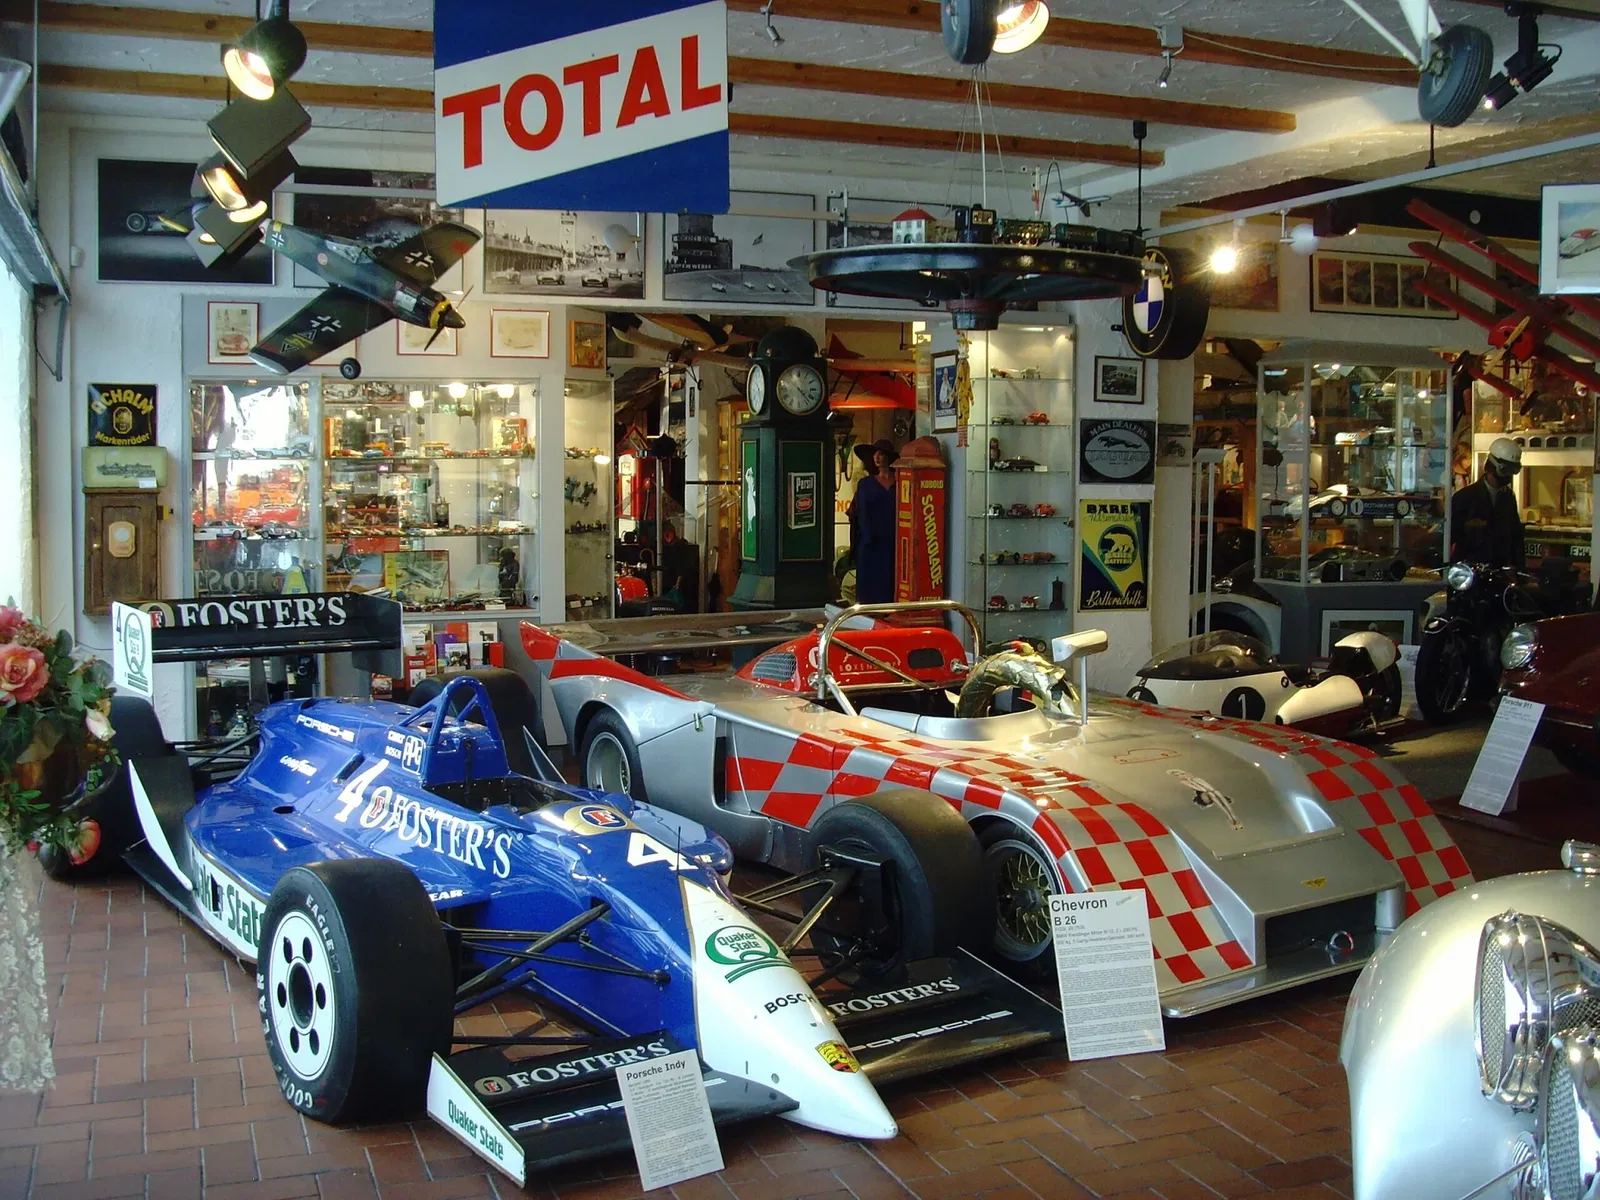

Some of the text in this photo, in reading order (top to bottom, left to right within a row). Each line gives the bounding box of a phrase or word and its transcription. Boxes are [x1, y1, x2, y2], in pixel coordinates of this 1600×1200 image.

[442, 35, 721, 168] TOTAL
[91, 389, 154, 415] ACHALM
[95, 431, 150, 445] Markenräder
[1085, 423, 1110, 437] MAIN
[1112, 421, 1148, 438] DEALERS
[796, 477, 813, 492] Persil
[922, 494, 942, 590] SCHOKOLADE
[178, 596, 347, 629] FOSTER'S
[1239, 693, 1246, 719] 1
[1502, 698, 1523, 706] Porsche
[296, 714, 355, 742] PORSCHE
[334, 759, 389, 822] 4
[382, 794, 513, 879] FOSTER'S
[627, 832, 699, 871] 4
[1051, 898, 1108, 912] Chevron
[306, 894, 335, 951] EAGLE
[1054, 915, 1077, 926] B 26
[716, 932, 757, 946] Quaker
[730, 940, 761, 952] State
[764, 992, 815, 1014] BOSCH
[828, 978, 960, 1016] FOSTER'S
[850, 1010, 1013, 1052] PORSCHE
[507, 1041, 671, 1089] FOSTER'S
[626, 1059, 686, 1081] Porsche Indy
[448, 1099, 504, 1160] Quaker State
